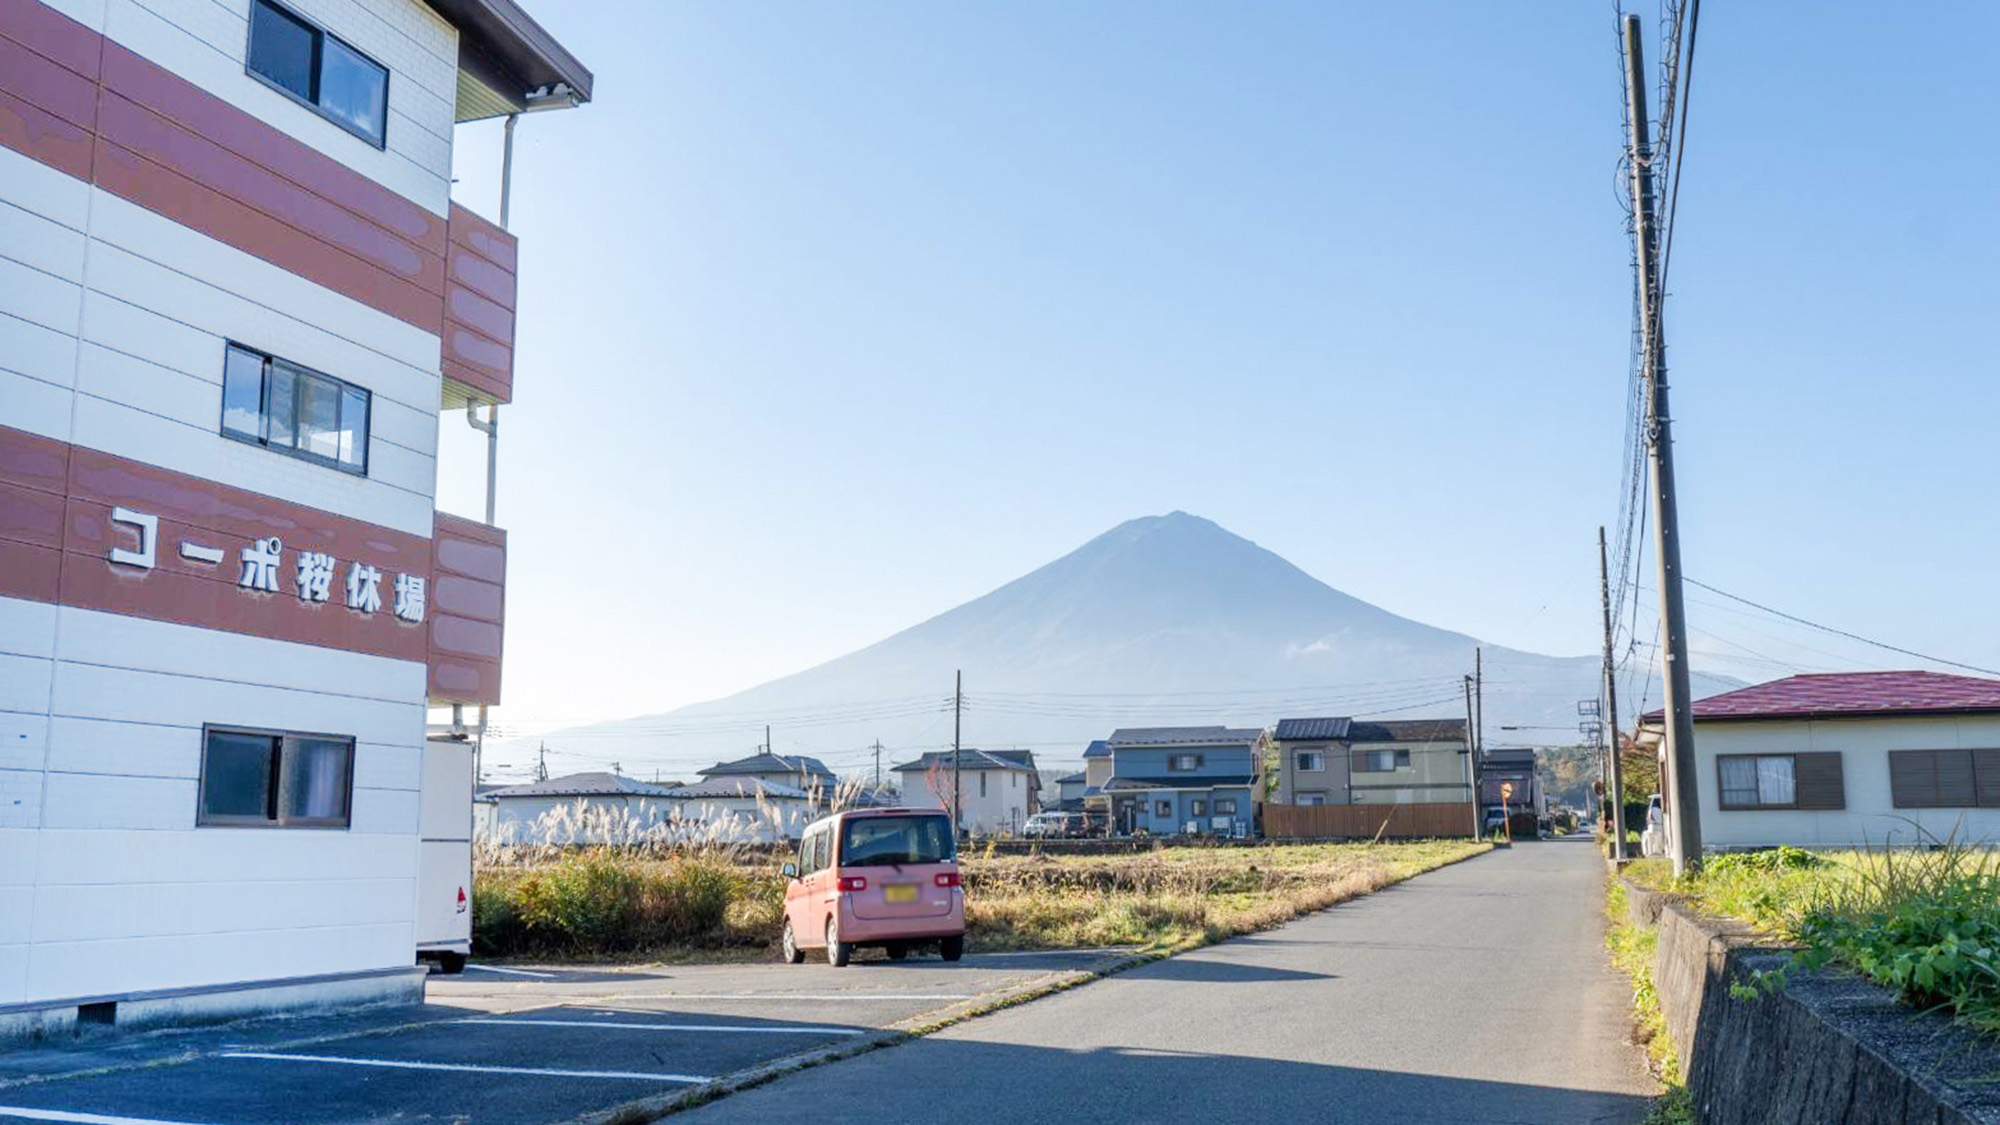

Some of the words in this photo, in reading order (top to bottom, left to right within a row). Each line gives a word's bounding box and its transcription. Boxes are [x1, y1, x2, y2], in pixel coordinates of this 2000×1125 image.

[110, 506, 426, 623] コーポ桜休場
